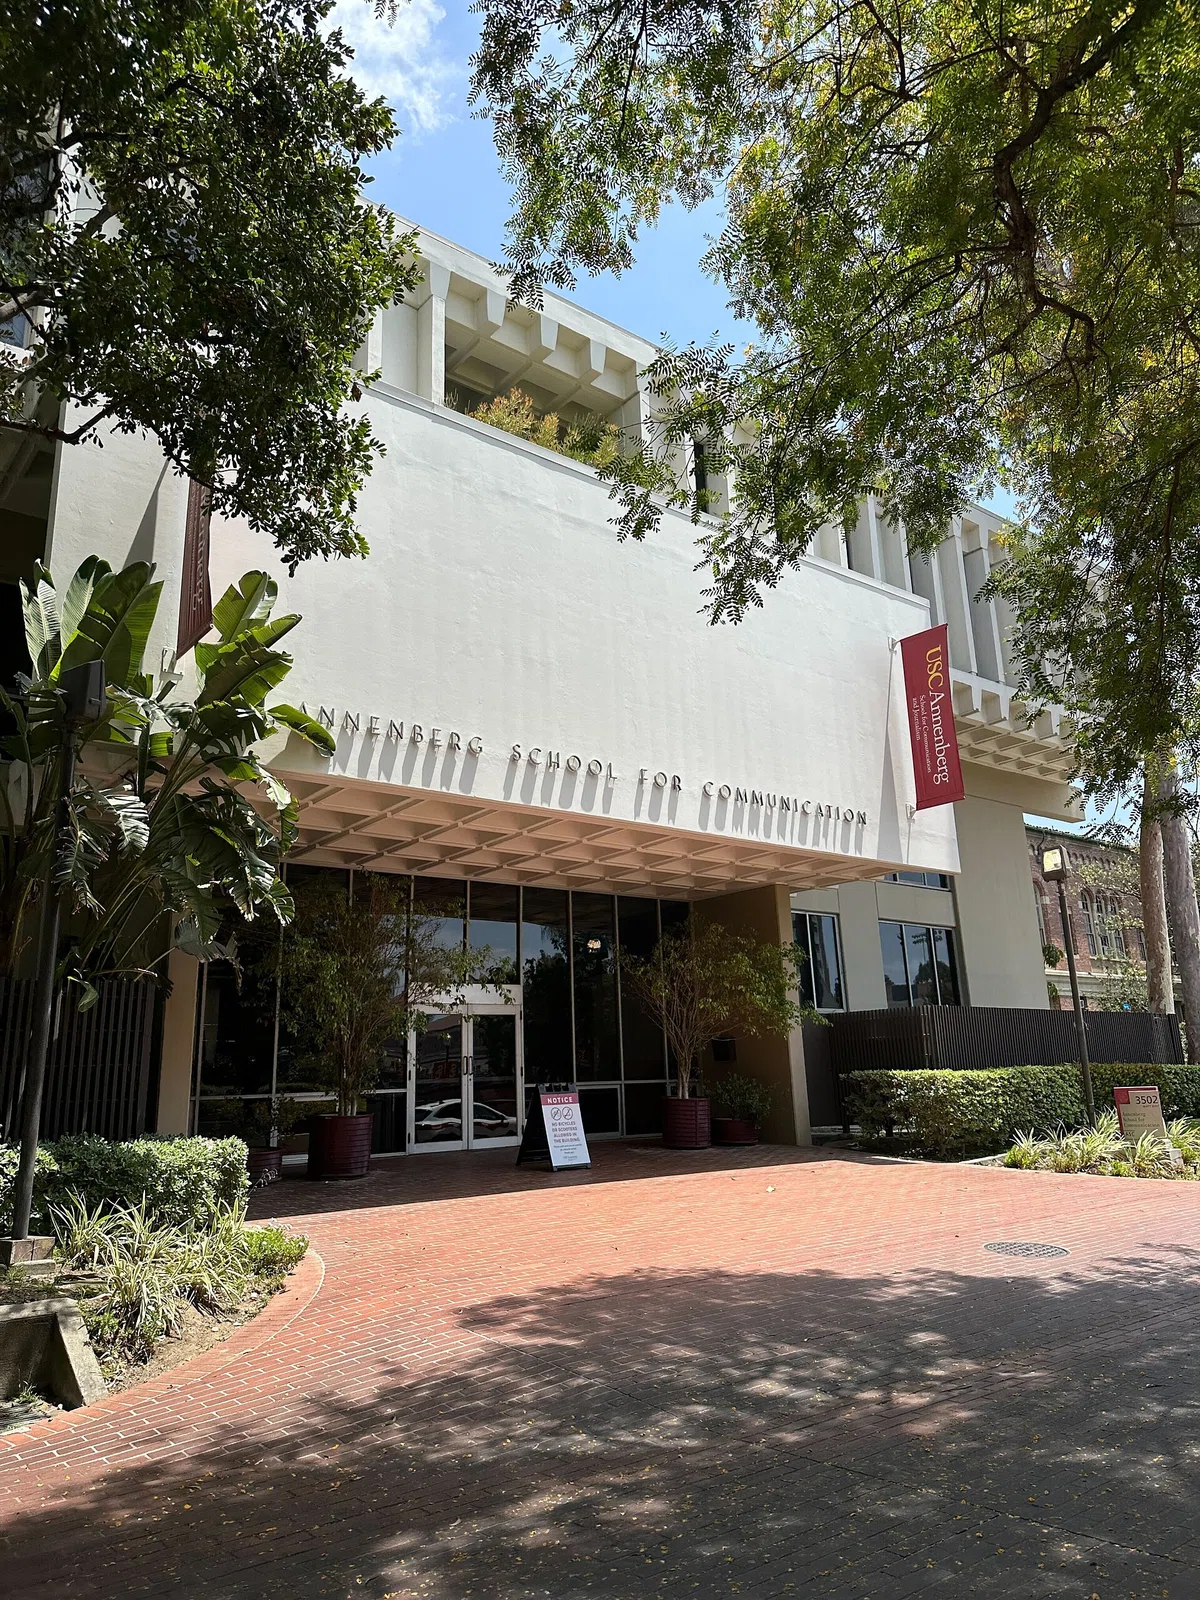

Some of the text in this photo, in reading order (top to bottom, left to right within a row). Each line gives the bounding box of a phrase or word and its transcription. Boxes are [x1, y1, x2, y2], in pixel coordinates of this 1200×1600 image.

[912, 697, 922, 740] and Journalism
[920, 694, 928, 716] School
[926, 643, 951, 785] USC Annenberg
[299, 701, 867, 826] ANNENBERG SCHOOL FOR COMMUNICATION
[922, 725, 932, 773] Communication
[1135, 1096, 1158, 1104] 3502
